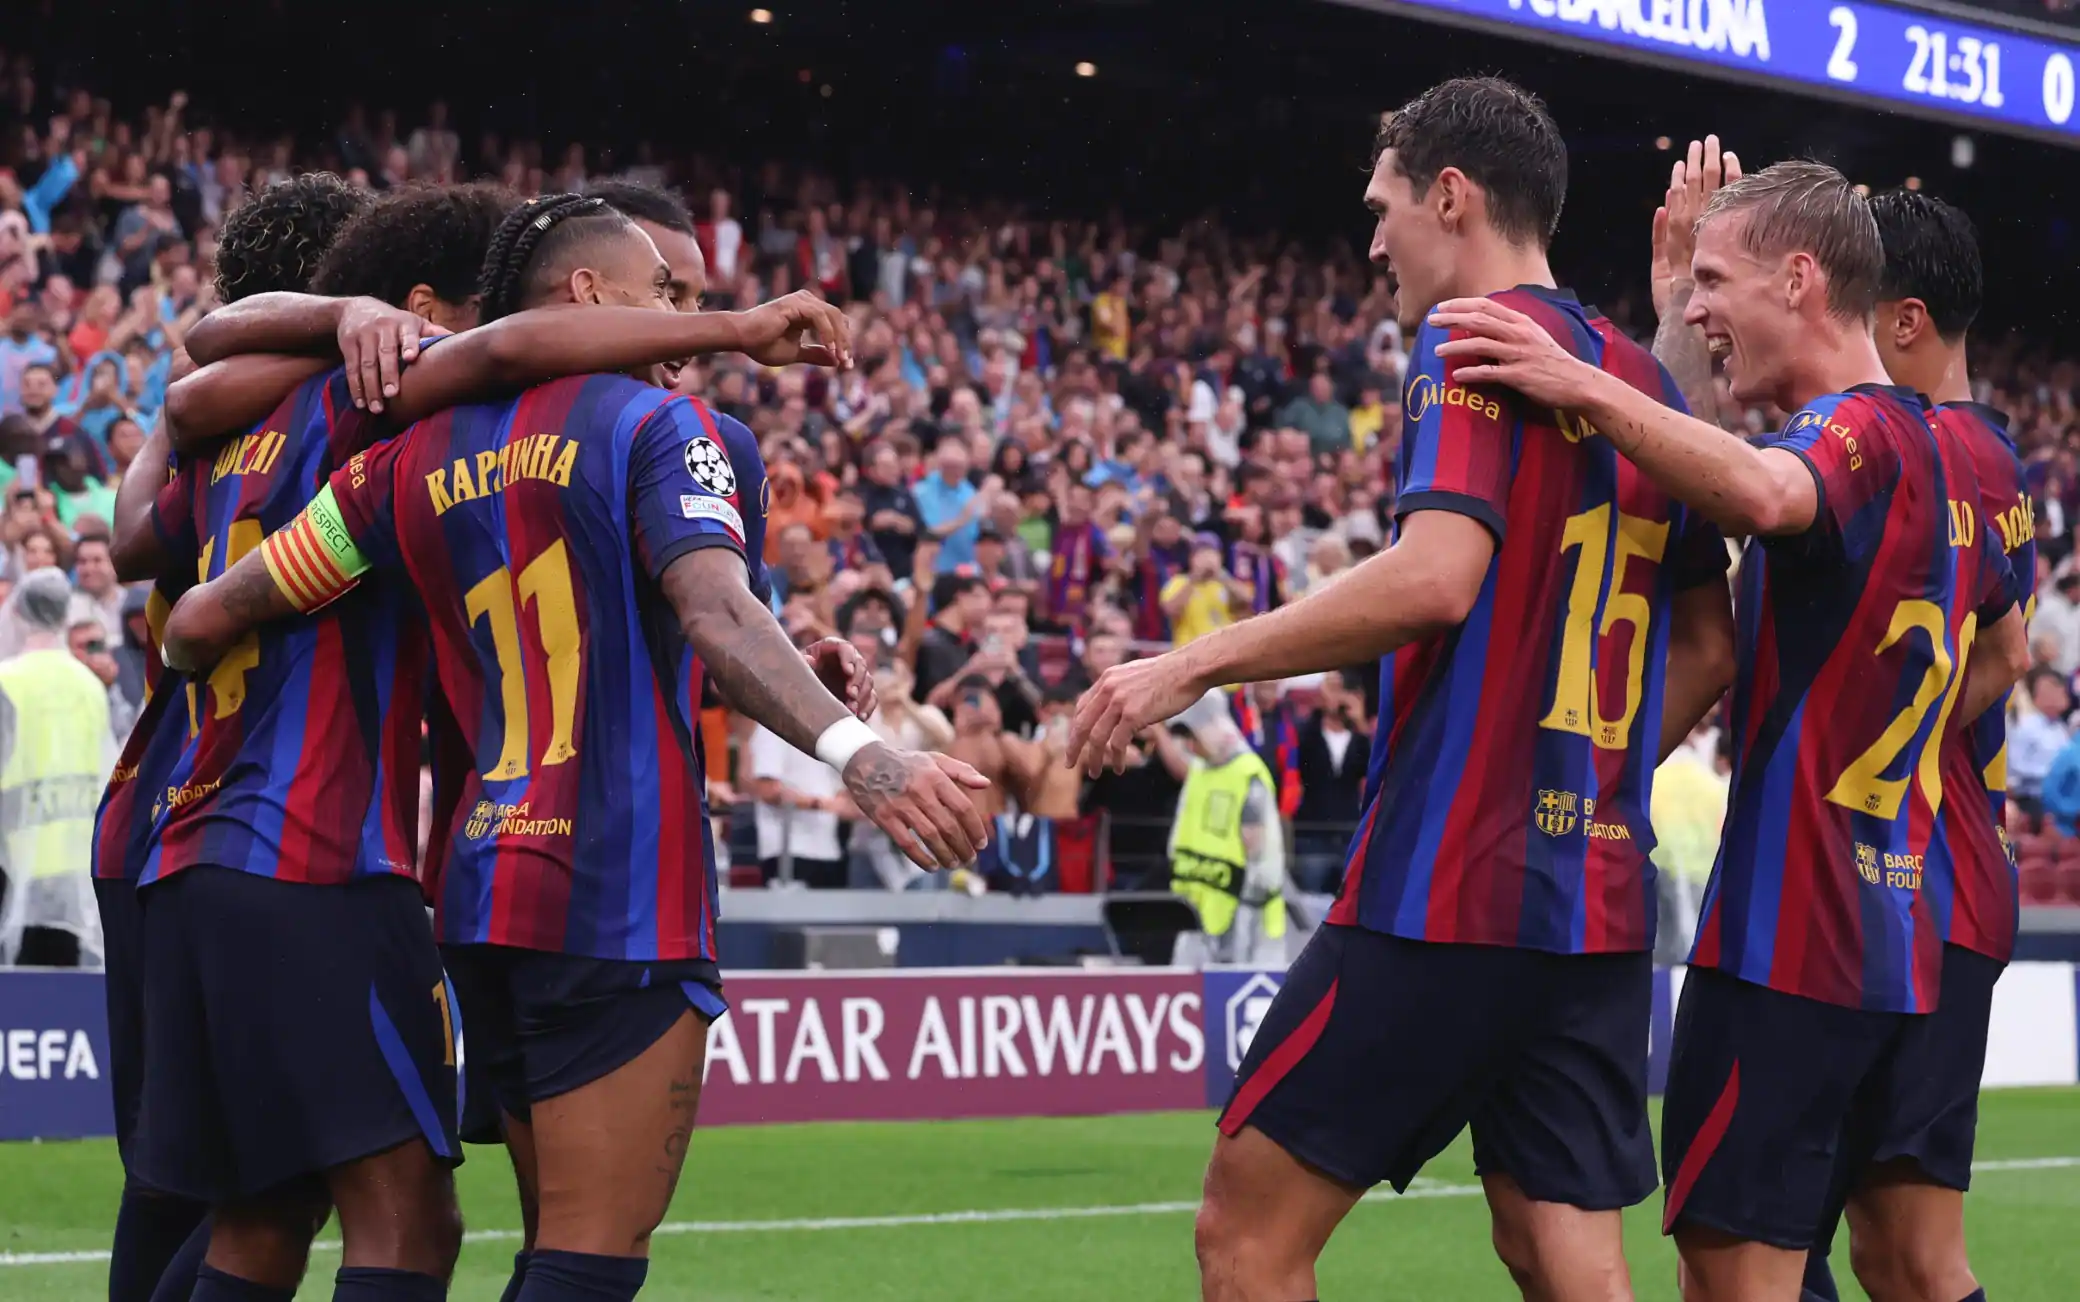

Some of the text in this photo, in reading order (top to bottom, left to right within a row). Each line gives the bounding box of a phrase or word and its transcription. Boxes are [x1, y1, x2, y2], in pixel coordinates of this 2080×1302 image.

[1827, 6, 1858, 82] 2
[1902, 25, 2004, 108] 21:31
[2043, 53, 2075, 124] 0
[1407, 374, 1500, 422] Midea
[1783, 410, 1862, 472] Midea
[311, 502, 352, 554] RESPECT
[1994, 490, 2036, 556] JOÃ
[1538, 501, 1670, 750] 15
[464, 537, 581, 782] 11
[0, 1029, 100, 1080] EFA
[702, 992, 1205, 1086] ATAR AIRWAYS
